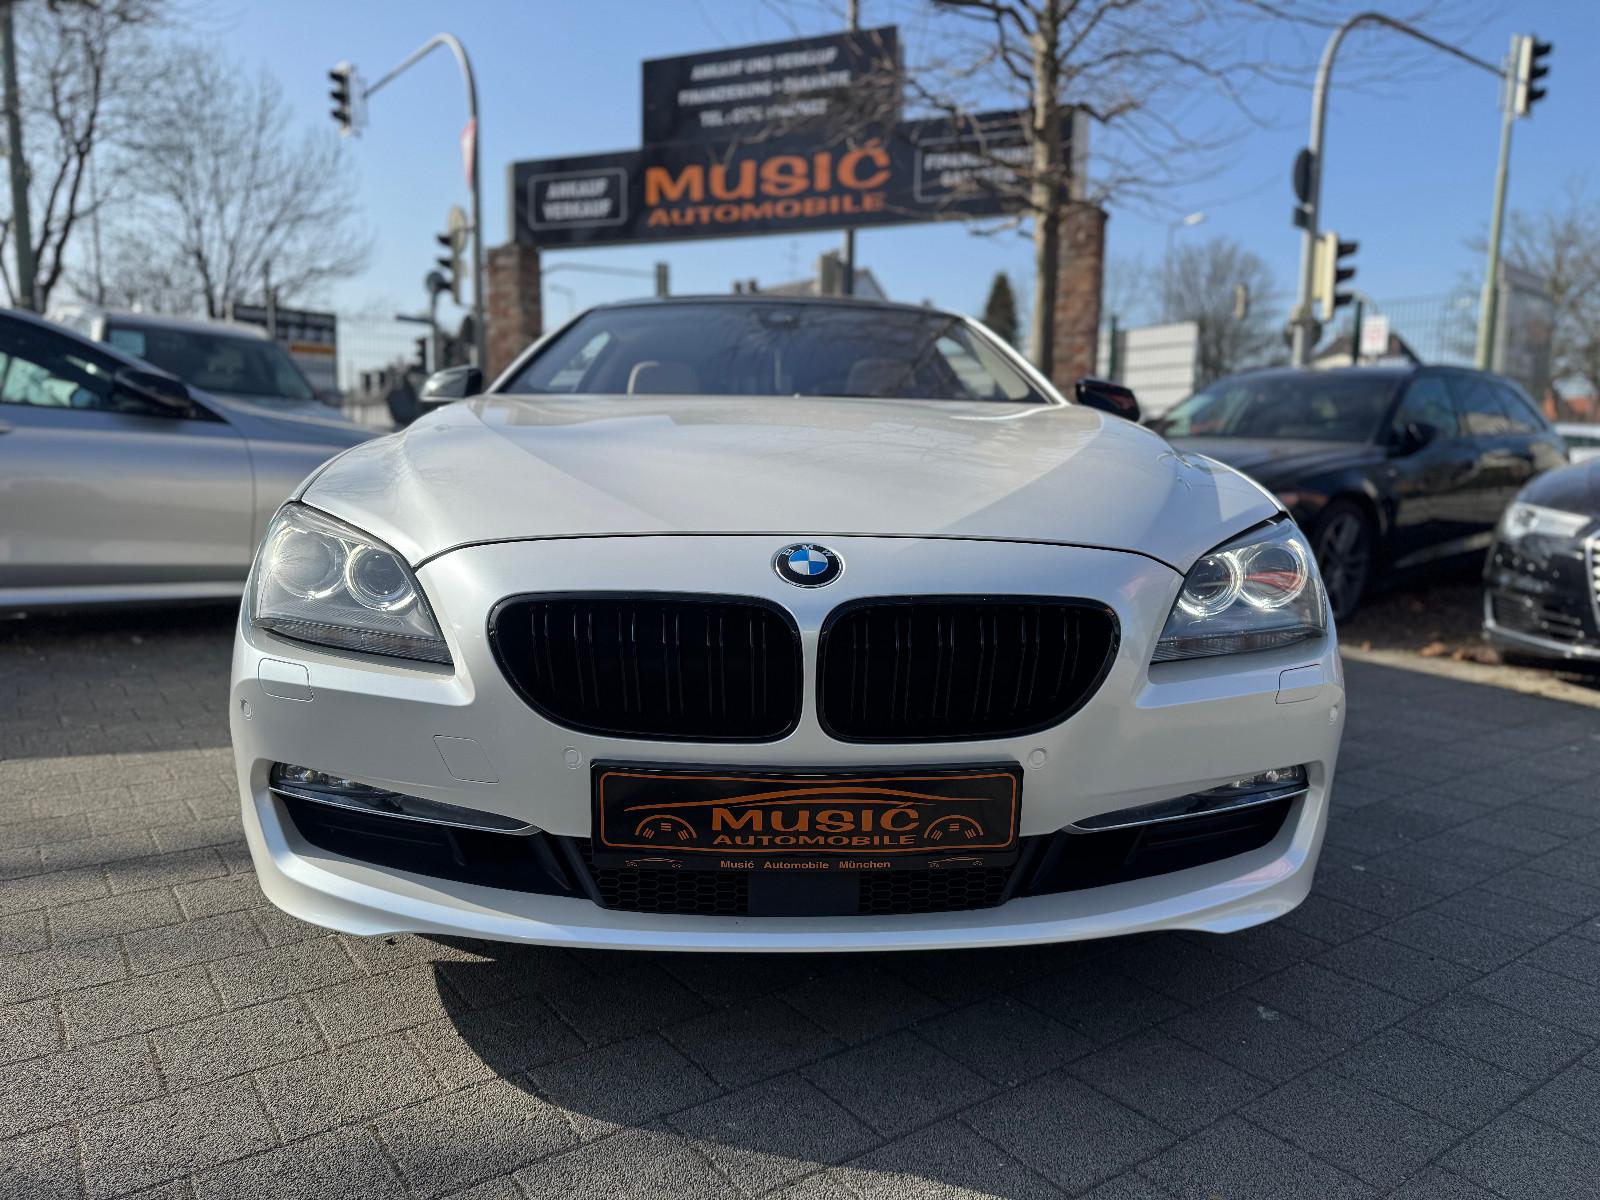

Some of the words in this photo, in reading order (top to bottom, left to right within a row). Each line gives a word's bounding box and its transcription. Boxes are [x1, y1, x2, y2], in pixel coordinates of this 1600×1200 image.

[645, 138, 891, 207] MUSIĆ
[648, 192, 886, 226] AUTOMOBILE
[711, 801, 920, 832] MUSIĆ
[712, 834, 918, 847] AUTOMOBILE
[720, 859, 755, 869] Musić
[763, 860, 830, 870] Automobile
[839, 860, 891, 870] München
